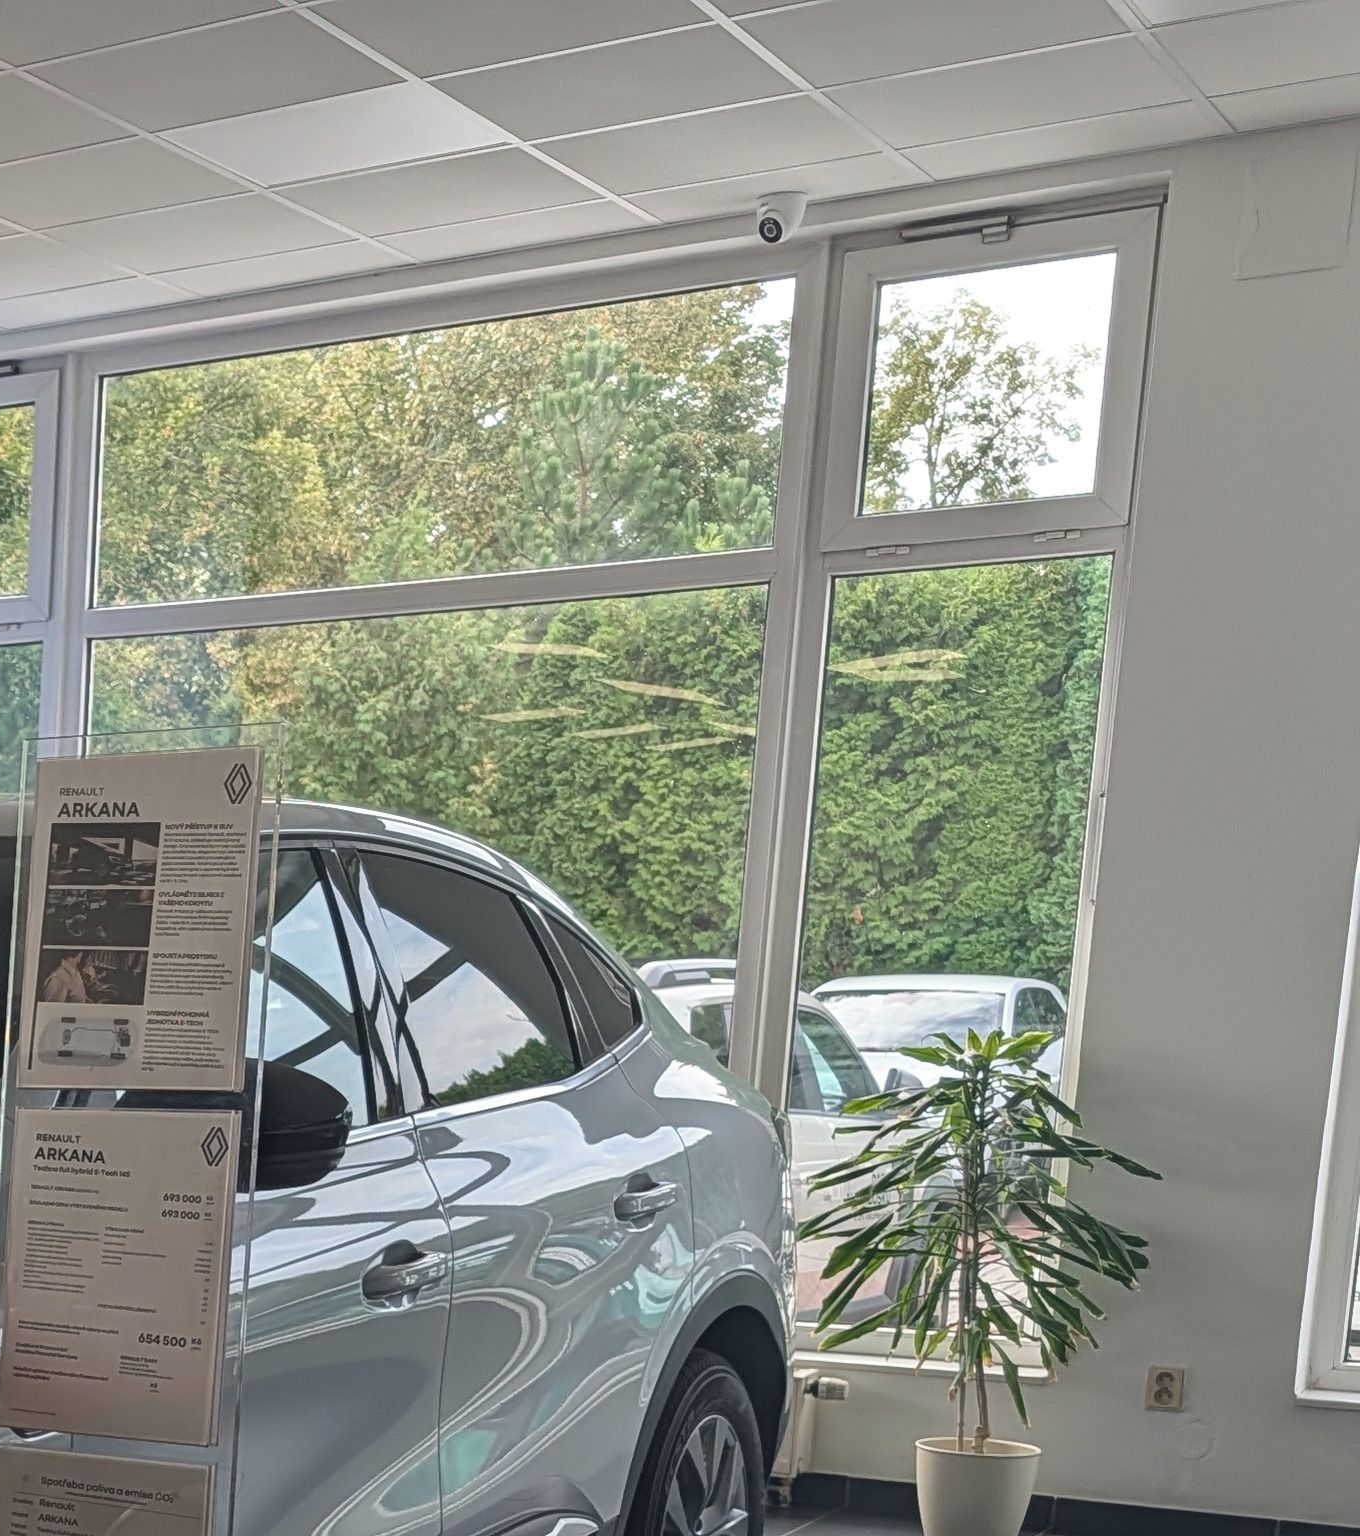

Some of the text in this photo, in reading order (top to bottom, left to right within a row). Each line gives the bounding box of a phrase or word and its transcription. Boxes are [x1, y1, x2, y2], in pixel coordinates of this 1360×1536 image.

[59, 787, 105, 797] RENAULT
[57, 801, 140, 818] ARKANA
[35, 1133, 82, 1144] RENAULT
[34, 1146, 106, 1164] ARKANA
[162, 1192, 181, 1202] 693
[182, 1194, 202, 1204] 000
[161, 1208, 179, 1219] 693
[180, 1210, 200, 1220] 000
[138, 1332, 161, 1345] 654
[162, 1335, 187, 1348] 500
[40, 1476, 84, 1490] Spotřeba
[86, 1482, 115, 1494] paliva
[116, 1488, 123, 1496] a
[124, 1489, 154, 1500] emise
[39, 1498, 76, 1512] Renault
[37, 1513, 79, 1527] ARKANA
